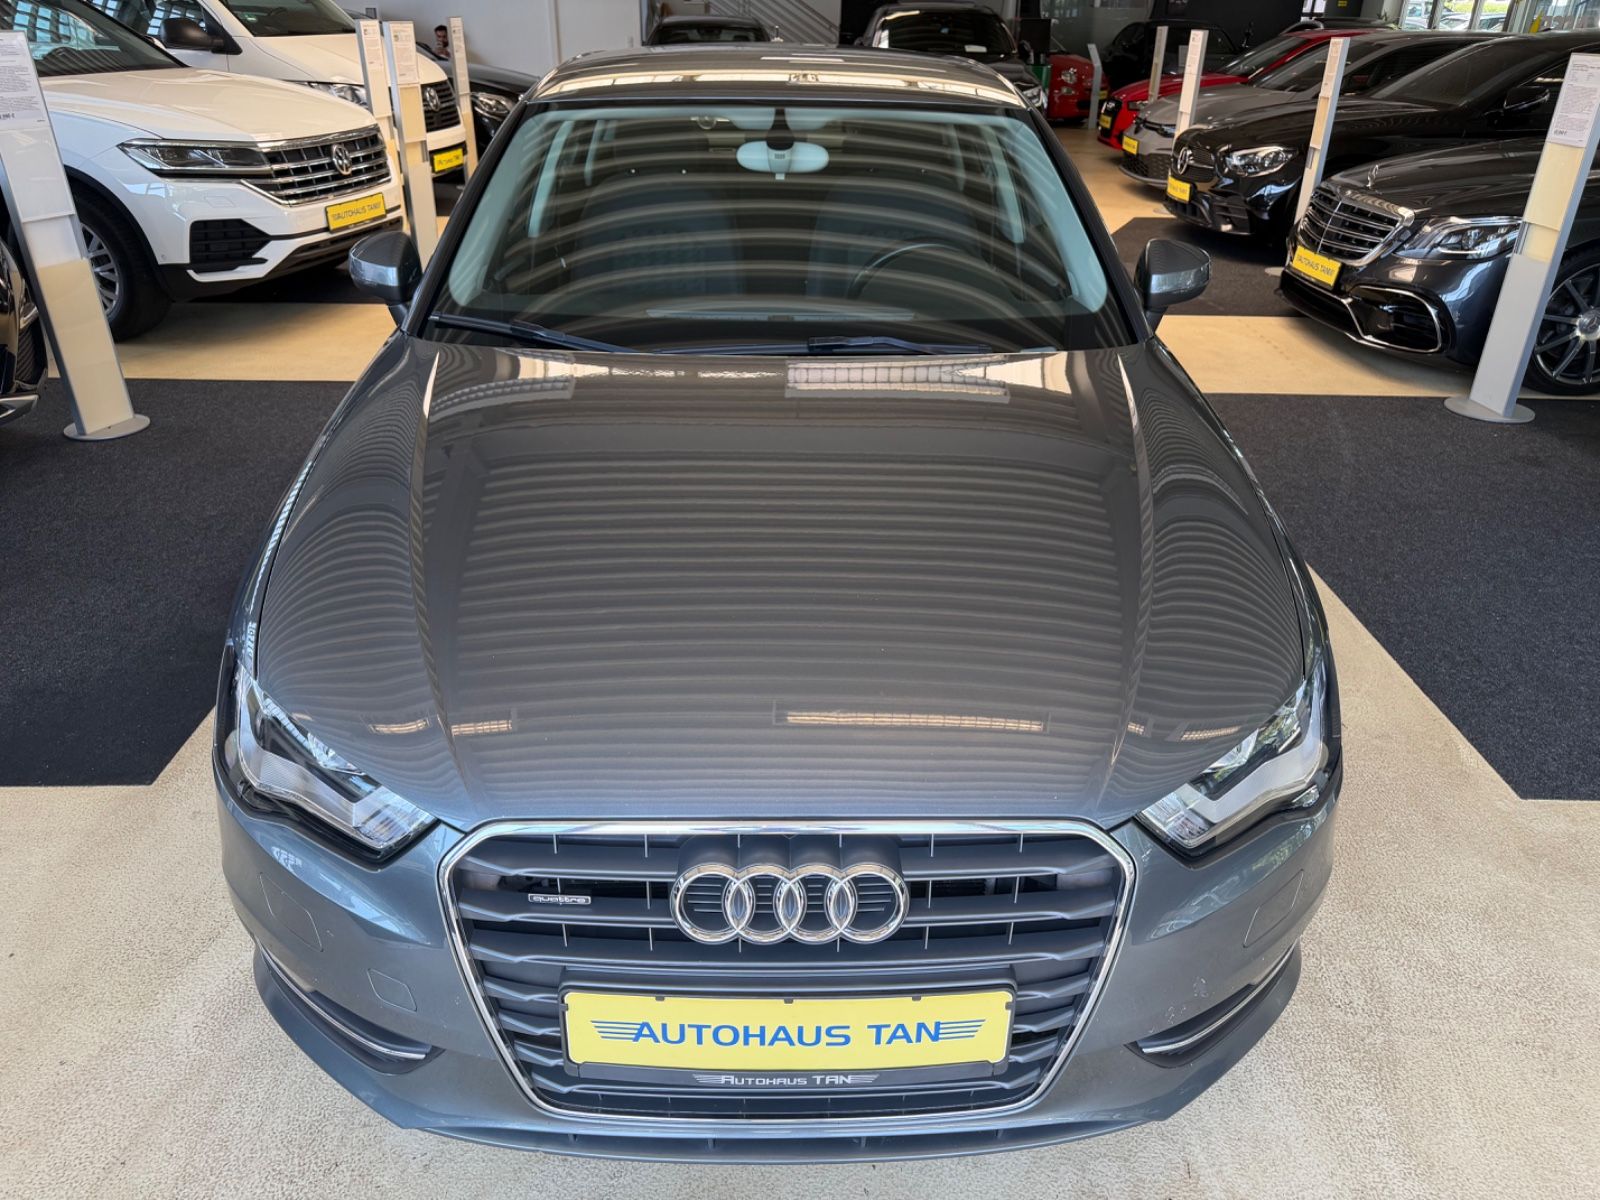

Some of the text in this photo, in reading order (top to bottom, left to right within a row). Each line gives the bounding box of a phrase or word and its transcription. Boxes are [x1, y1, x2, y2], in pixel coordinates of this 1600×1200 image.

[531, 895, 587, 904] quattro
[632, 1021, 941, 1047] AUTOHAUS TAN
[811, 1074, 852, 1085] TAN
